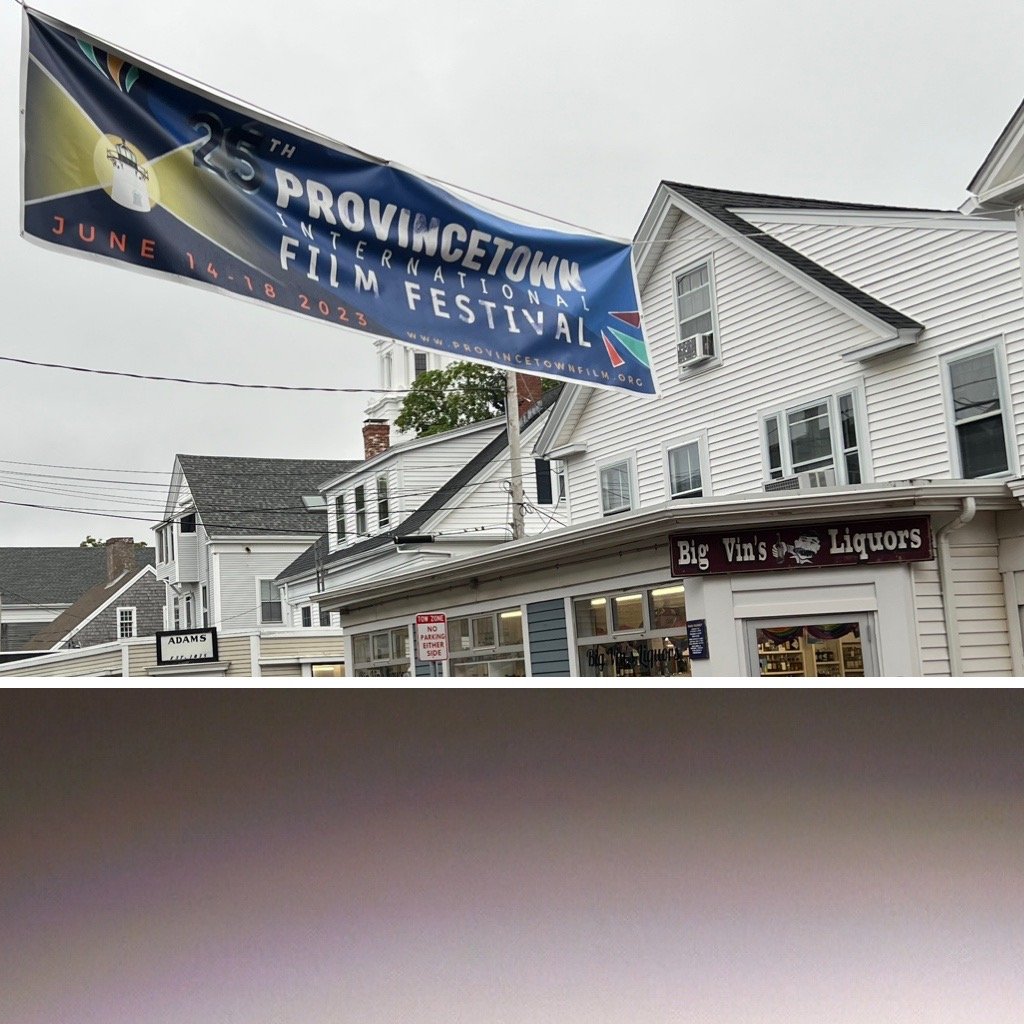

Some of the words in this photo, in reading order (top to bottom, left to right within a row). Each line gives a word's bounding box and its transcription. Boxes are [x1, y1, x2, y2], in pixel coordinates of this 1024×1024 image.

[275, 168, 587, 293] PROVINCETOWN
[52, 216, 156, 259] JUNE
[186, 252, 277, 298] 14-18
[298, 294, 368, 327] 2023
[276, 212, 590, 312] INTERNATIONAL
[280, 235, 380, 298] FILM
[404, 281, 592, 348] FESTIVAL
[406, 331, 644, 388] WWW.PROVINCETOWNFILM.ORG
[677, 540, 709, 571] Big
[723, 535, 767, 562] Vin's
[828, 528, 923, 559] Liquors
[168, 634, 207, 645] ADAMS
[422, 641, 445, 649] EITHER
[426, 649, 442, 657] SIDE
